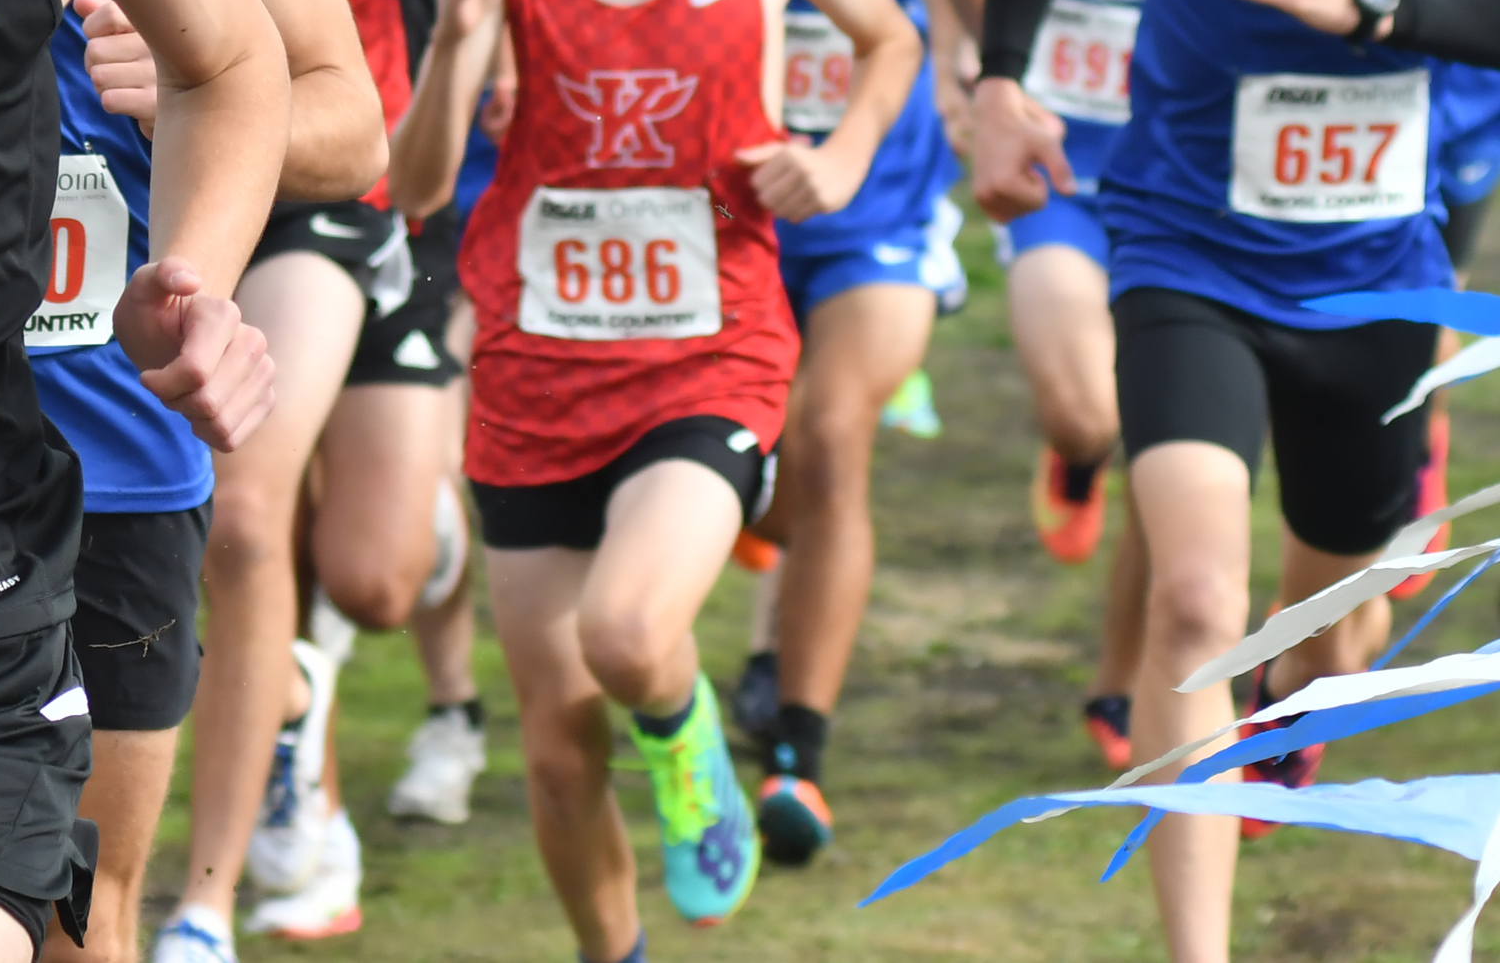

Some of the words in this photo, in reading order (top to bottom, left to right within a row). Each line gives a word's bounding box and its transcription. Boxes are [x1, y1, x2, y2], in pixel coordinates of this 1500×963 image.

[784, 52, 851, 104] 69
[1273, 123, 1399, 186] 657
[553, 237, 681, 304] 686
